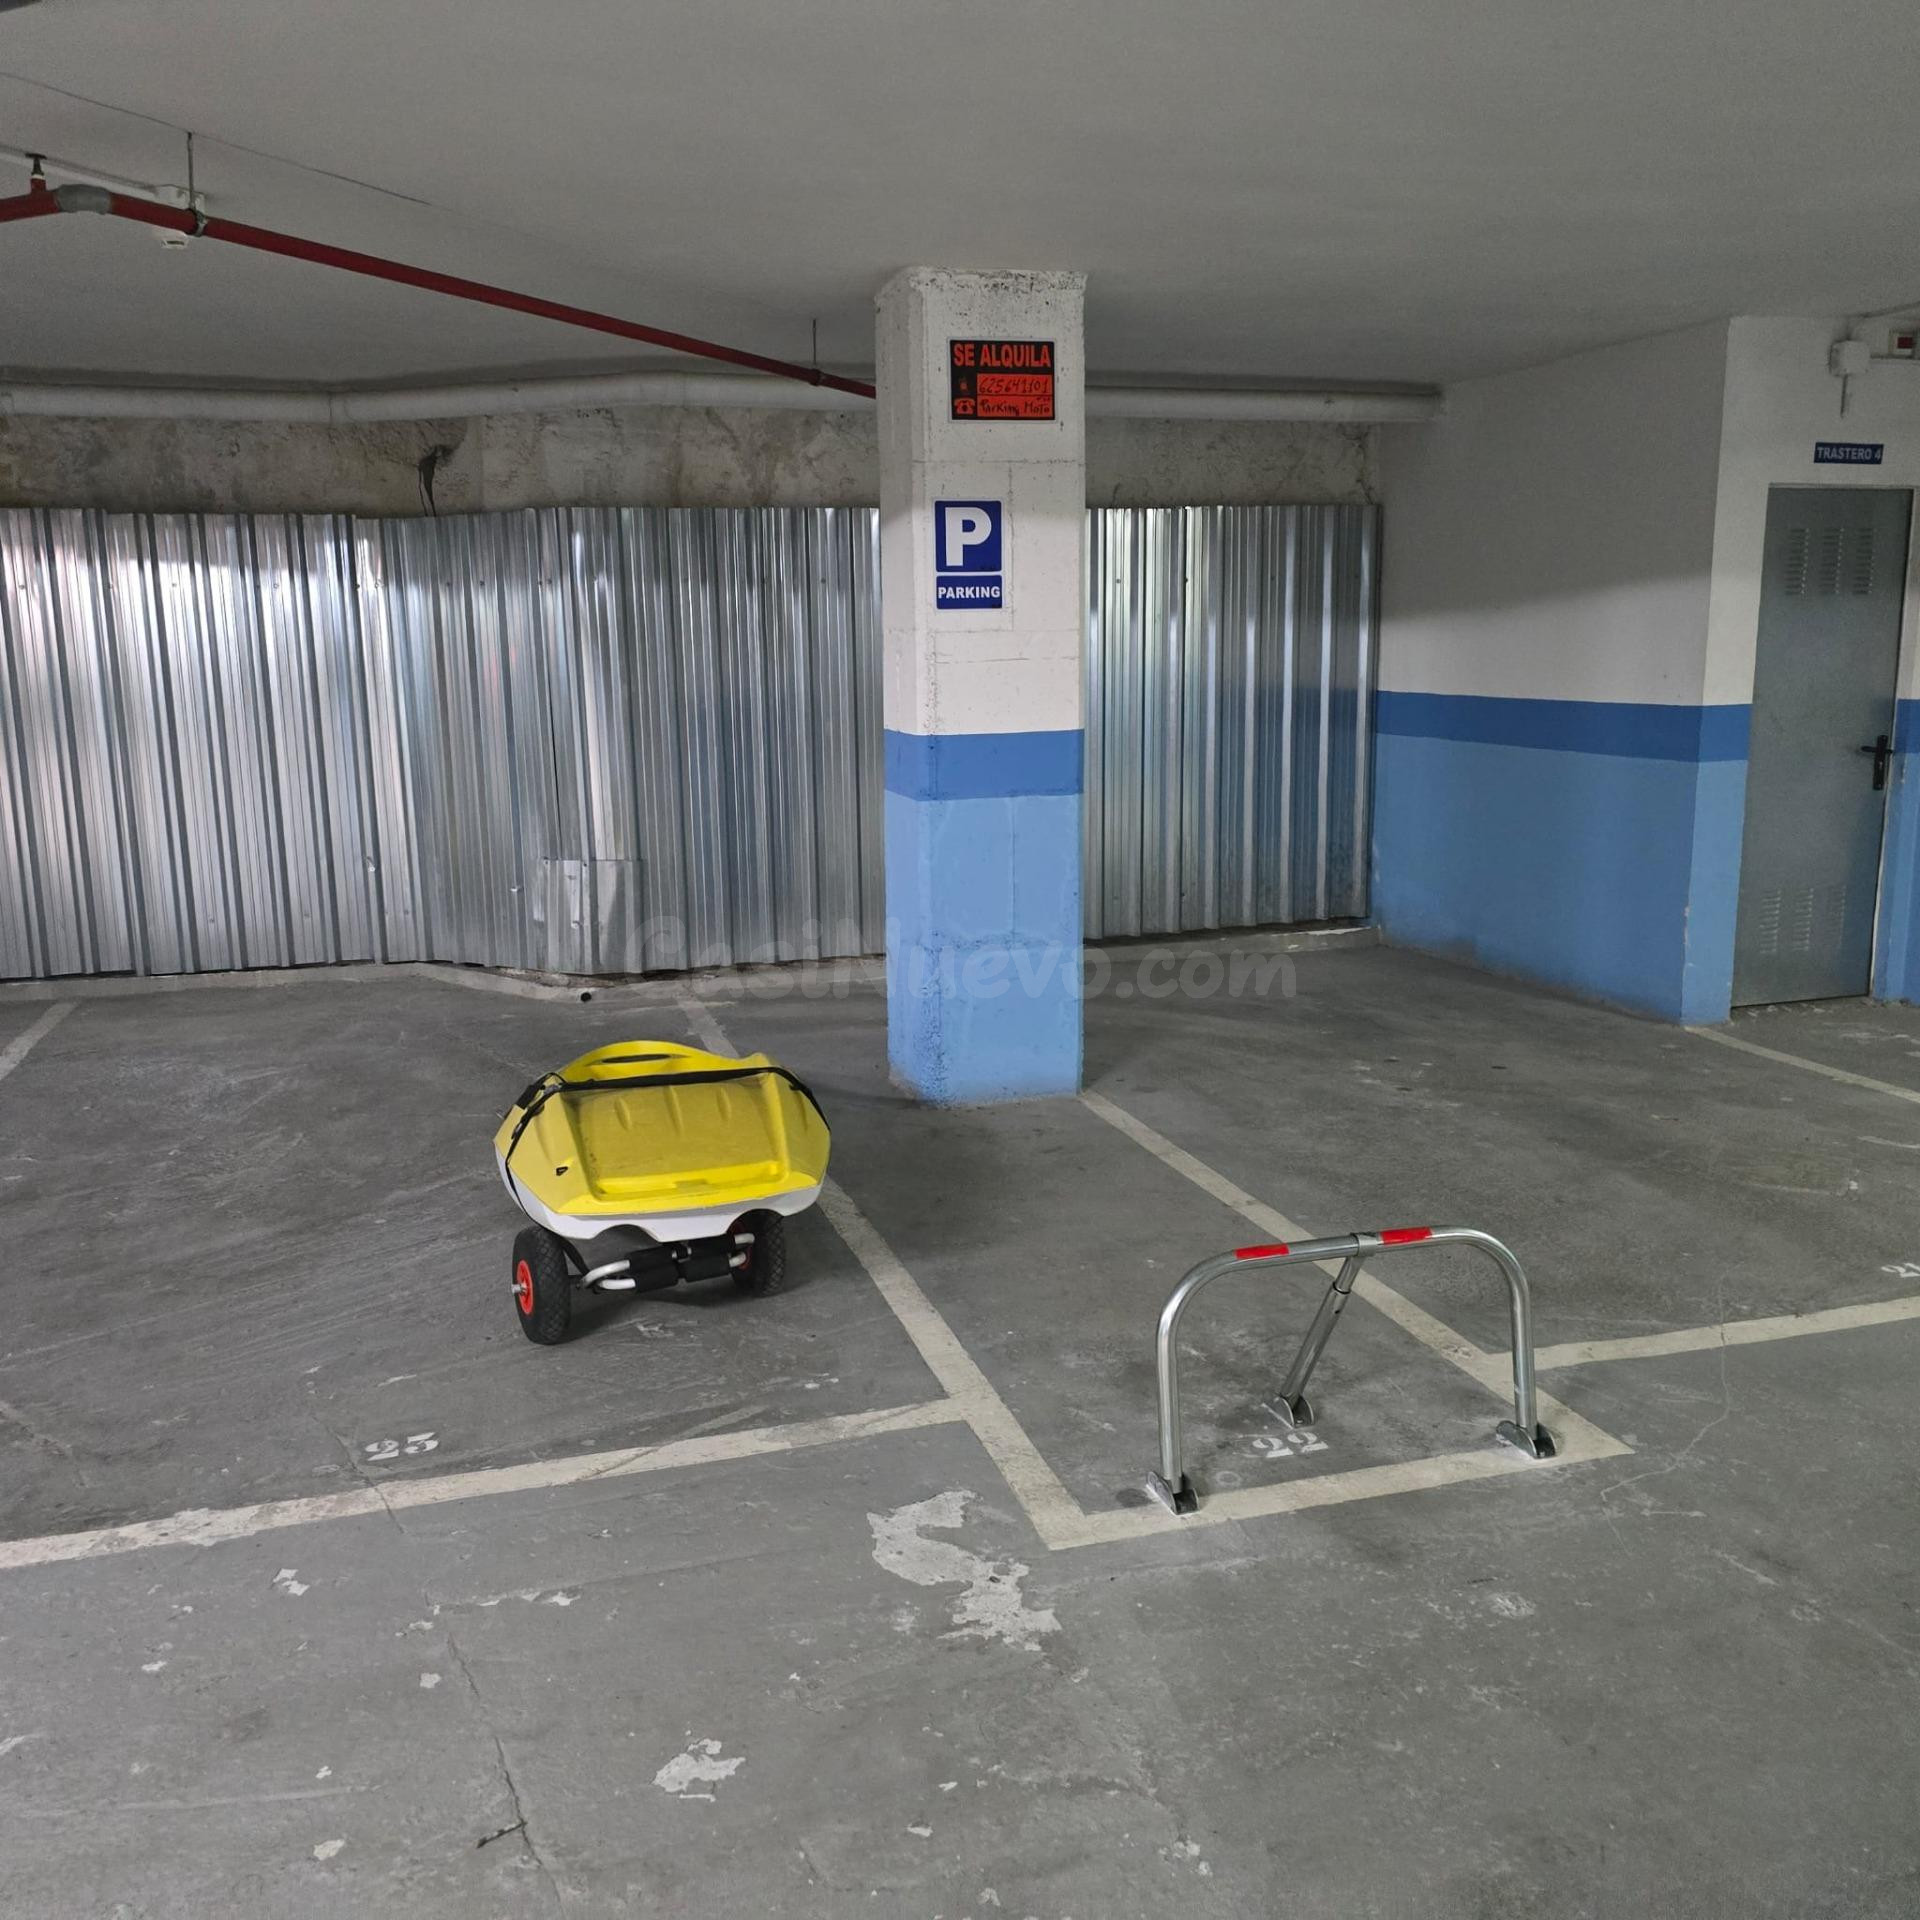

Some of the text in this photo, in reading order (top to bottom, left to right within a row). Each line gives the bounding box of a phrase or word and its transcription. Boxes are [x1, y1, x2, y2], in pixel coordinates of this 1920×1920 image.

[953, 343, 1051, 368] SE ALQUILA
[1816, 446, 1882, 461] TRASTERO 4
[944, 506, 992, 567] P
[937, 585, 1001, 599] PARKING
[1252, 1431, 1329, 1458] 22
